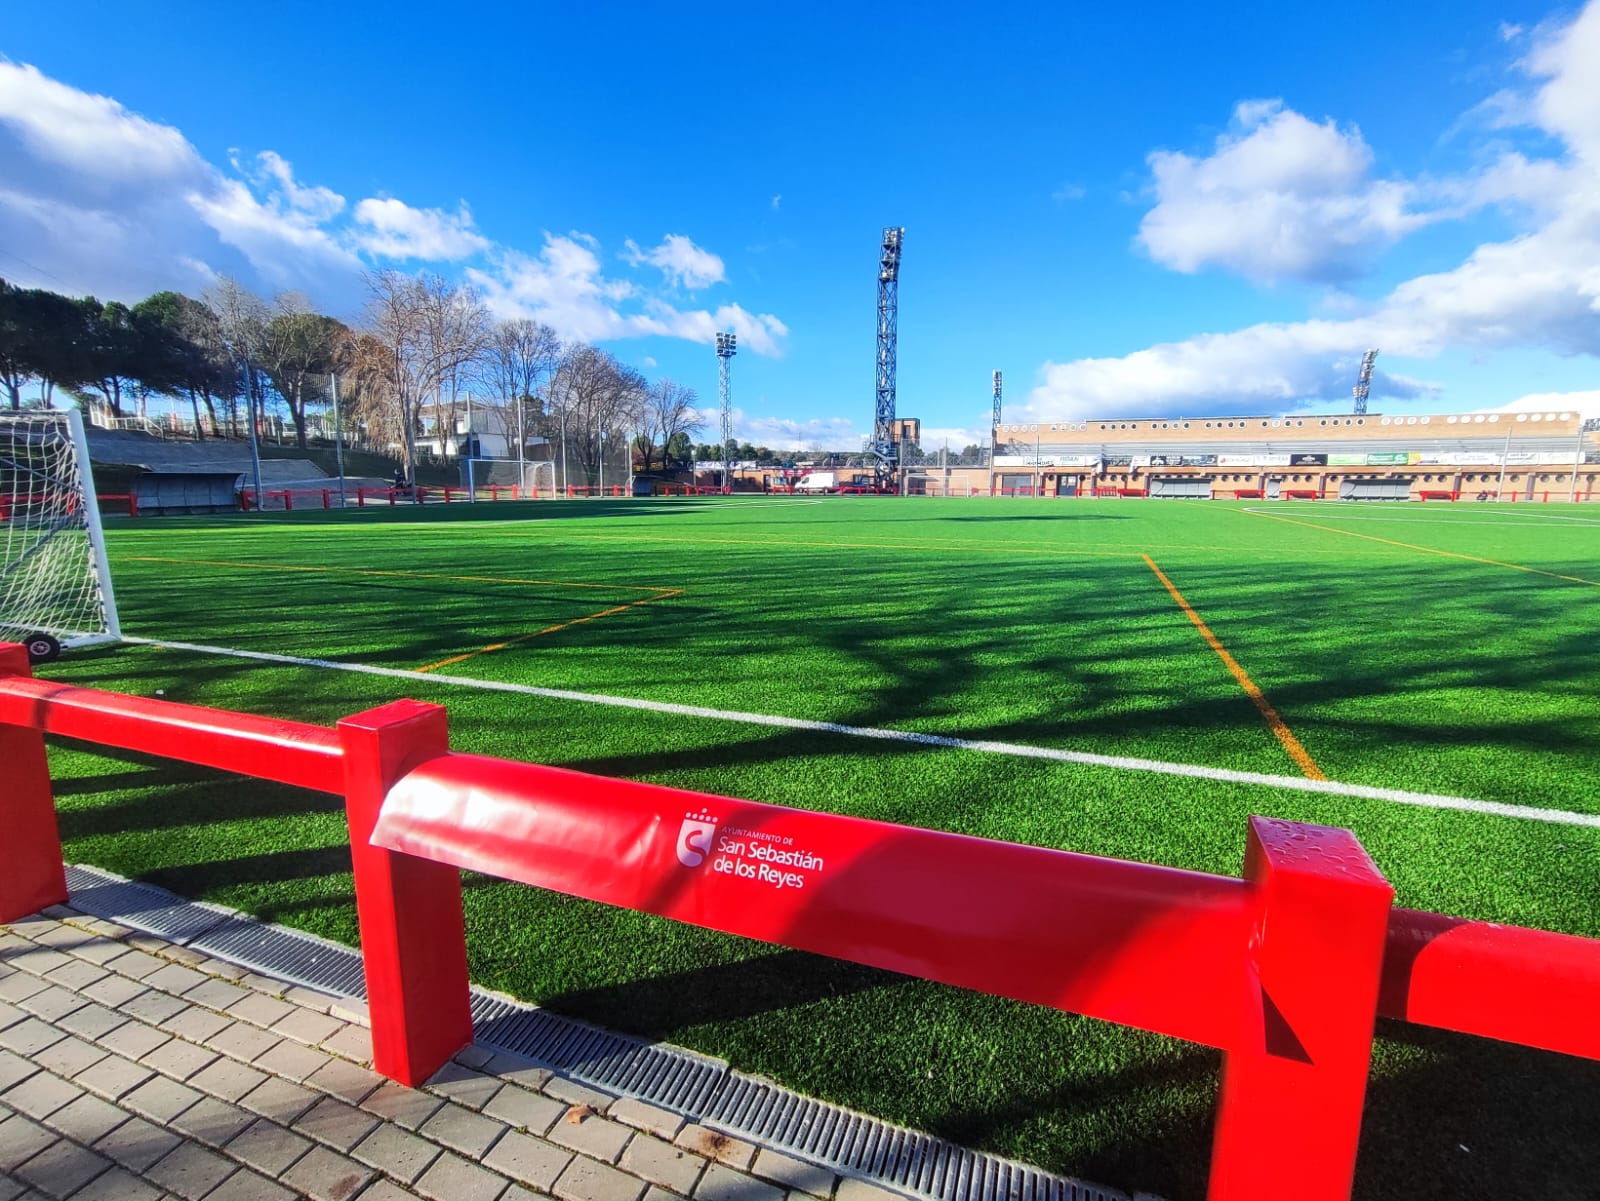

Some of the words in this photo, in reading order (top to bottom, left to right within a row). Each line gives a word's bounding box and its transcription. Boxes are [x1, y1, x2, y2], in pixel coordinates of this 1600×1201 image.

[721, 826, 781, 843] AYUNTAMIENTO
[782, 837, 794, 846] DE
[717, 836, 745, 856] San
[747, 842, 824, 871] Sebastián
[713, 855, 733, 874] de
[734, 858, 756, 878] los
[758, 863, 804, 889] Reyes
